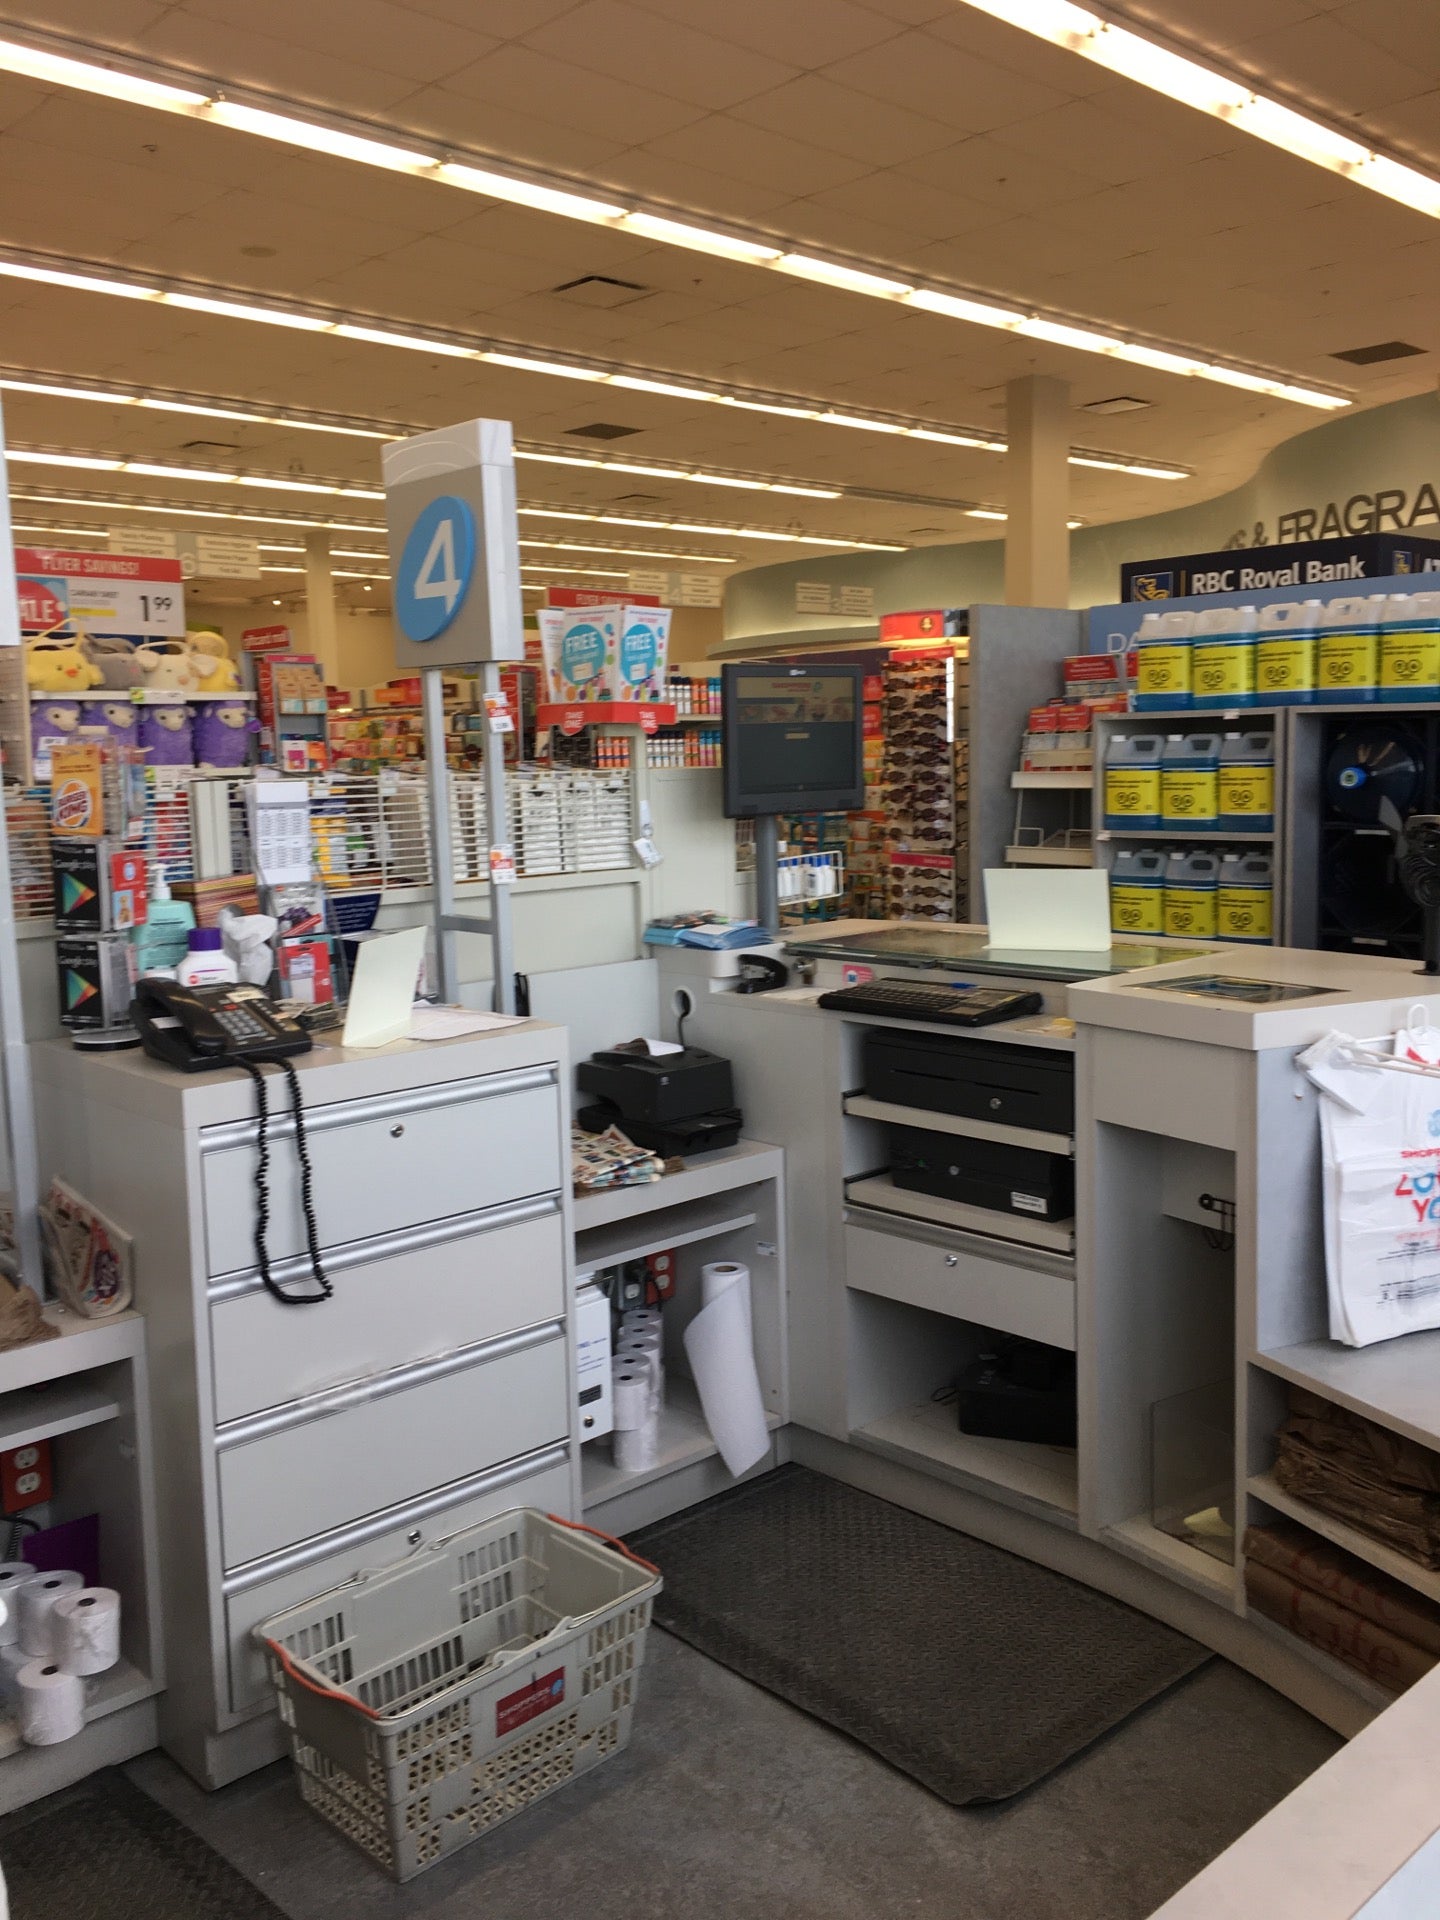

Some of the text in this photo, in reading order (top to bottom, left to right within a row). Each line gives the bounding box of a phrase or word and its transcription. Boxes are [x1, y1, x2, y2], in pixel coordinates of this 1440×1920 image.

[414, 518, 463, 616] 4
[1191, 555, 1366, 595] RBC Royal Bank
[140, 595, 172, 621] 1 99
[565, 631, 599, 653] FREE
[625, 632, 652, 651] FREE
